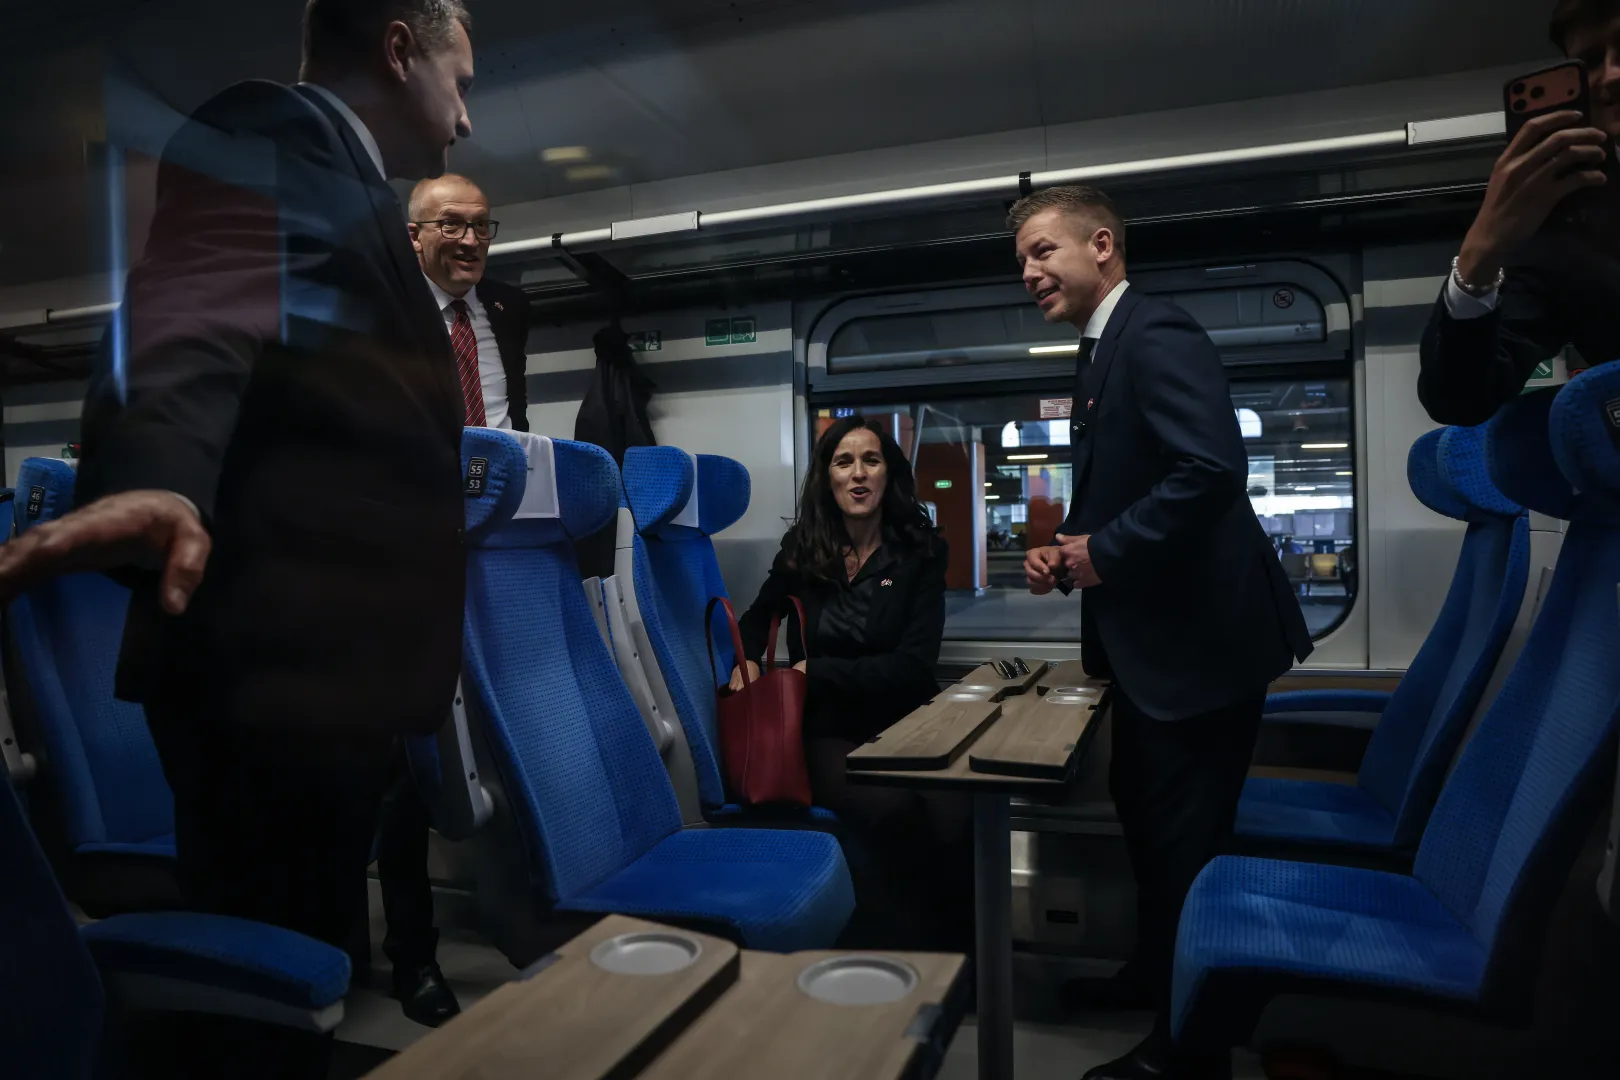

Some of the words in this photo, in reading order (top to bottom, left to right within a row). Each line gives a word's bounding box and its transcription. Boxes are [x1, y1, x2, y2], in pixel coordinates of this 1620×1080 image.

[470, 465, 482, 475] 55
[468, 479, 481, 489] 53
[31, 492, 40, 501] 46
